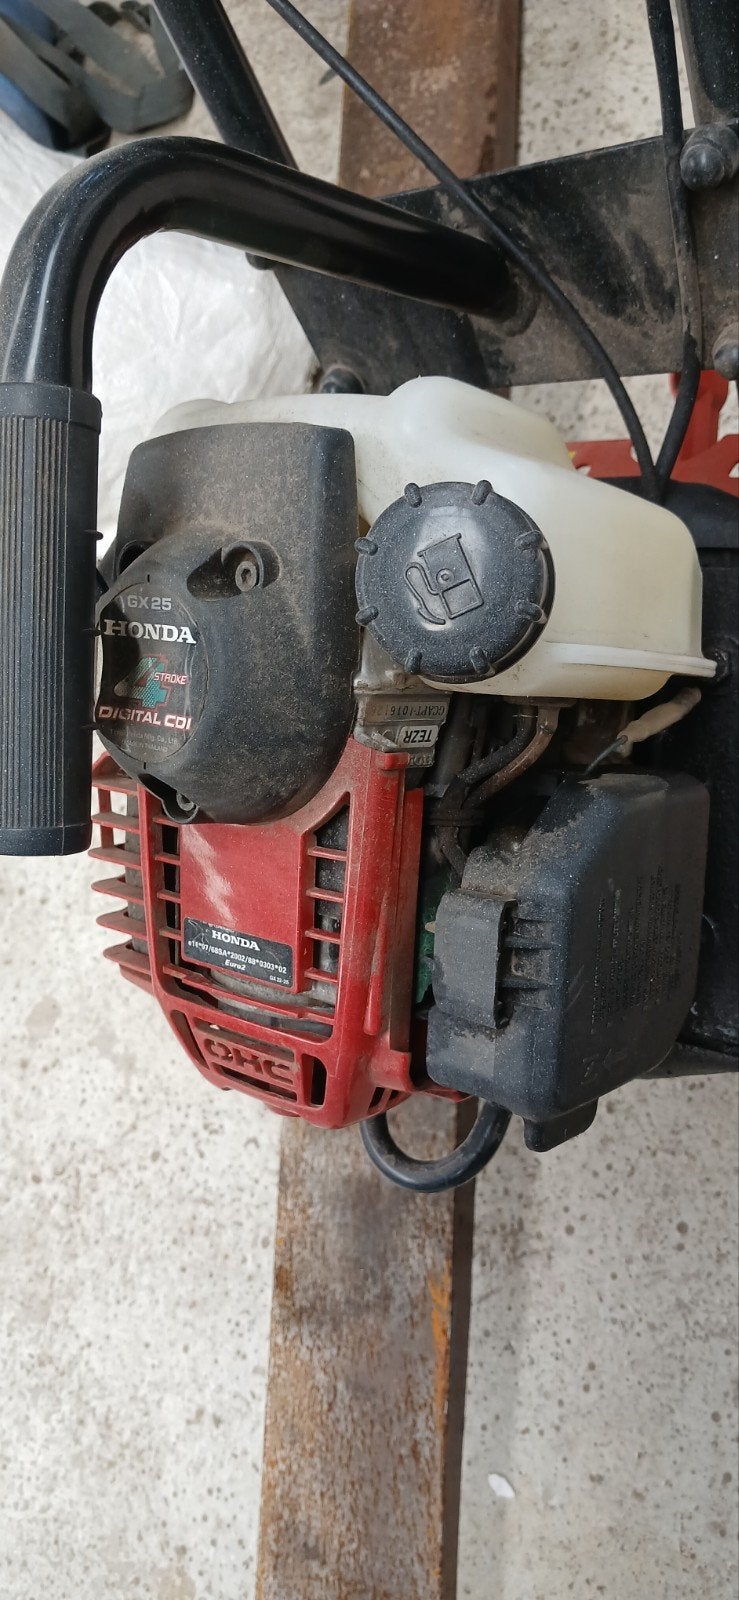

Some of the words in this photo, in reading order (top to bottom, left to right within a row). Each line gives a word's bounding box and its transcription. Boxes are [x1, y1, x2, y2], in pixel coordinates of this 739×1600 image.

[127, 594, 172, 611] GX25
[104, 619, 197, 645] HONDA
[153, 672, 189, 685] STROKE
[98, 705, 162, 727] DIGITAL
[163, 714, 193, 731] CDI
[402, 729, 432, 744] TEZR
[211, 929, 261, 952] HONDA
[224, 958, 247, 972] Euro2
[203, 1037, 294, 1086] OHC
